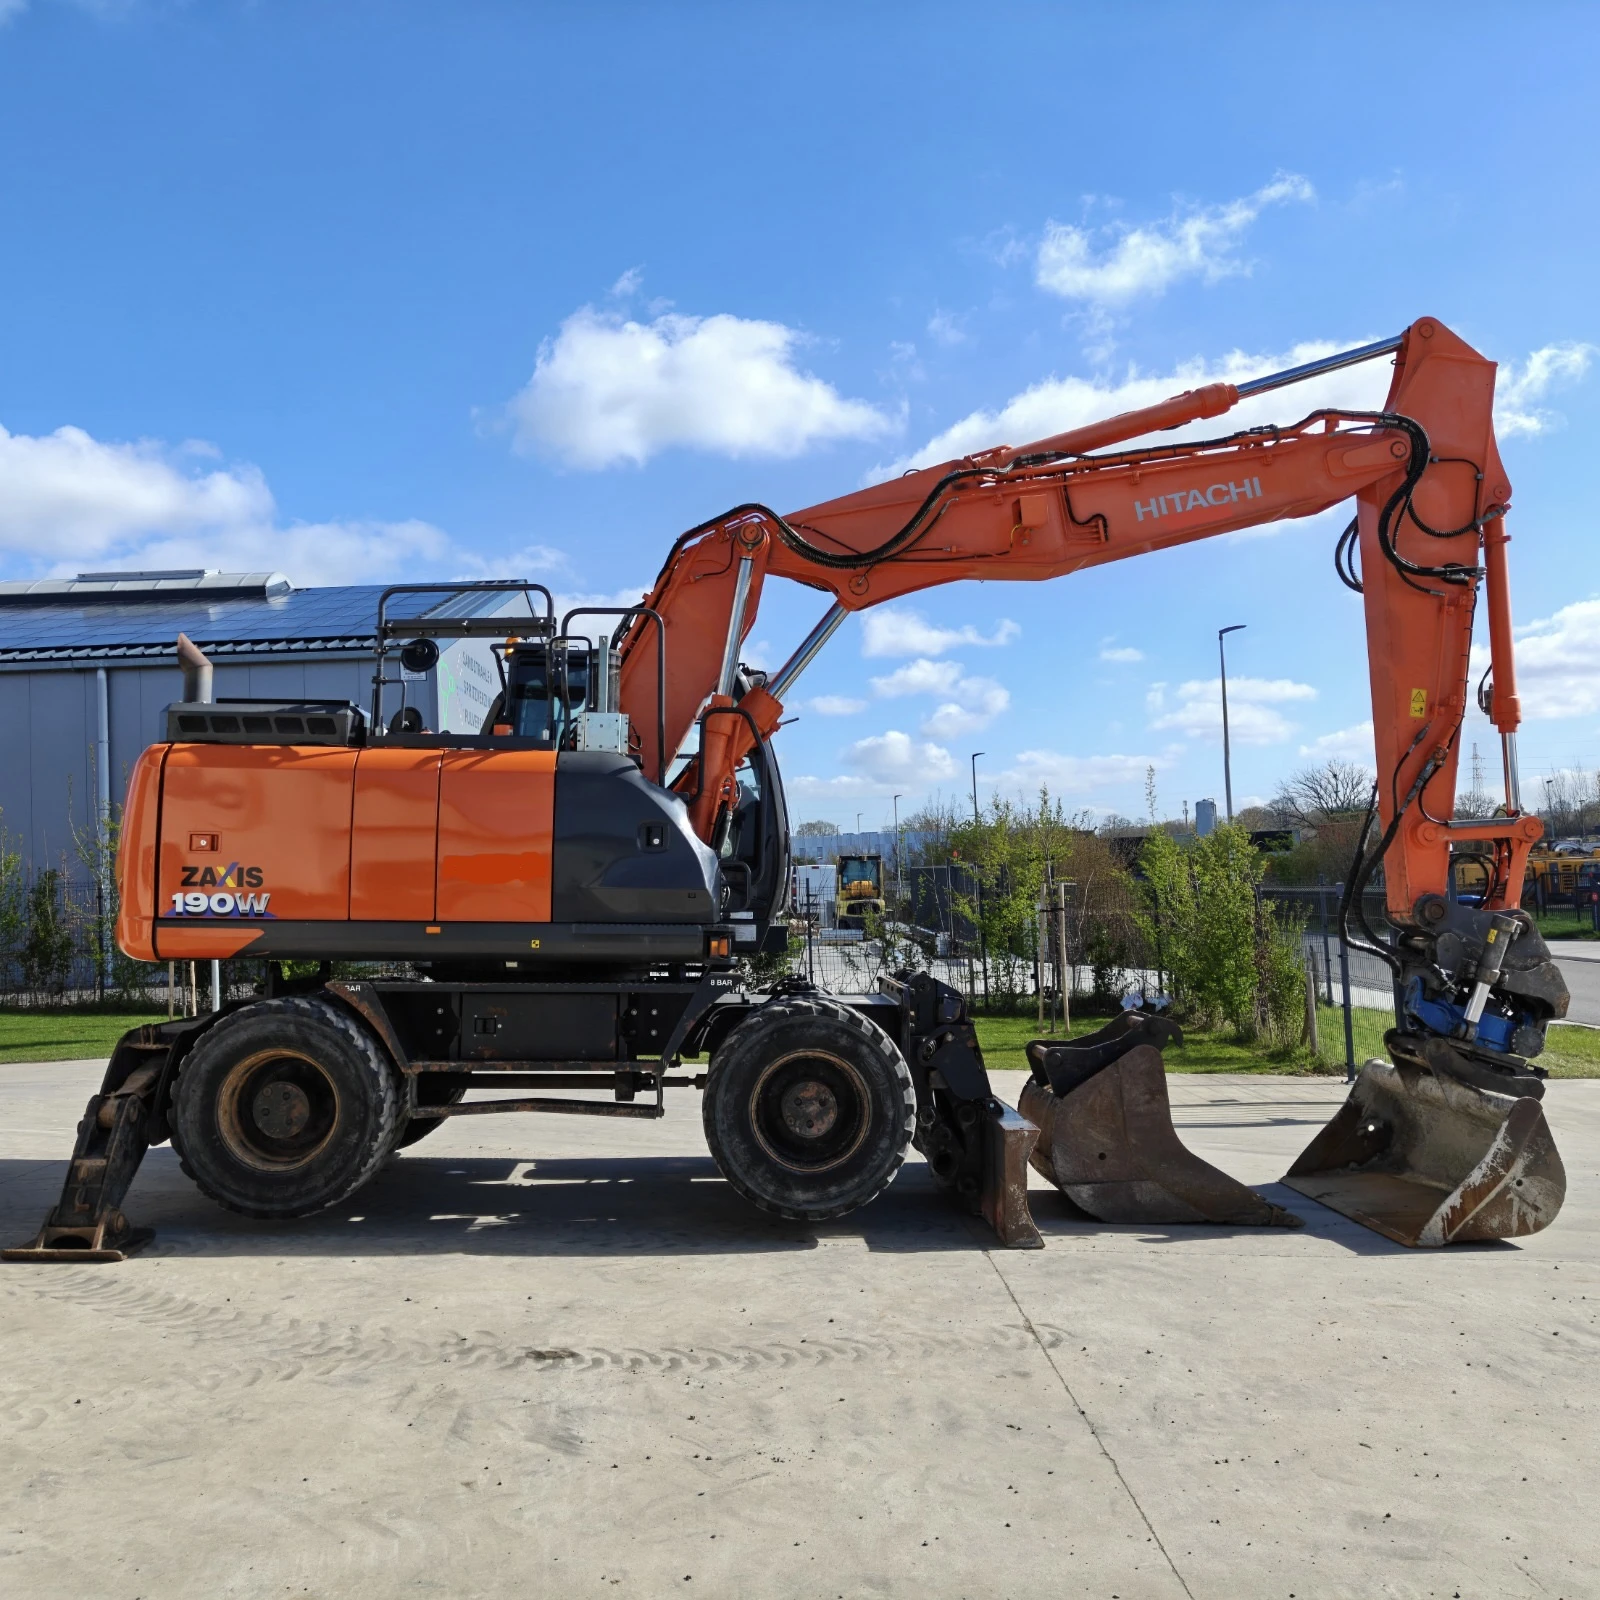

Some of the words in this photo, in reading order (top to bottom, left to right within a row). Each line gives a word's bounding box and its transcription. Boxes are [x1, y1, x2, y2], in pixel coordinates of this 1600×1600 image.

[1134, 476, 1263, 522] HITACHI
[180, 861, 264, 888] ZAXIS
[171, 892, 271, 915] 190W
